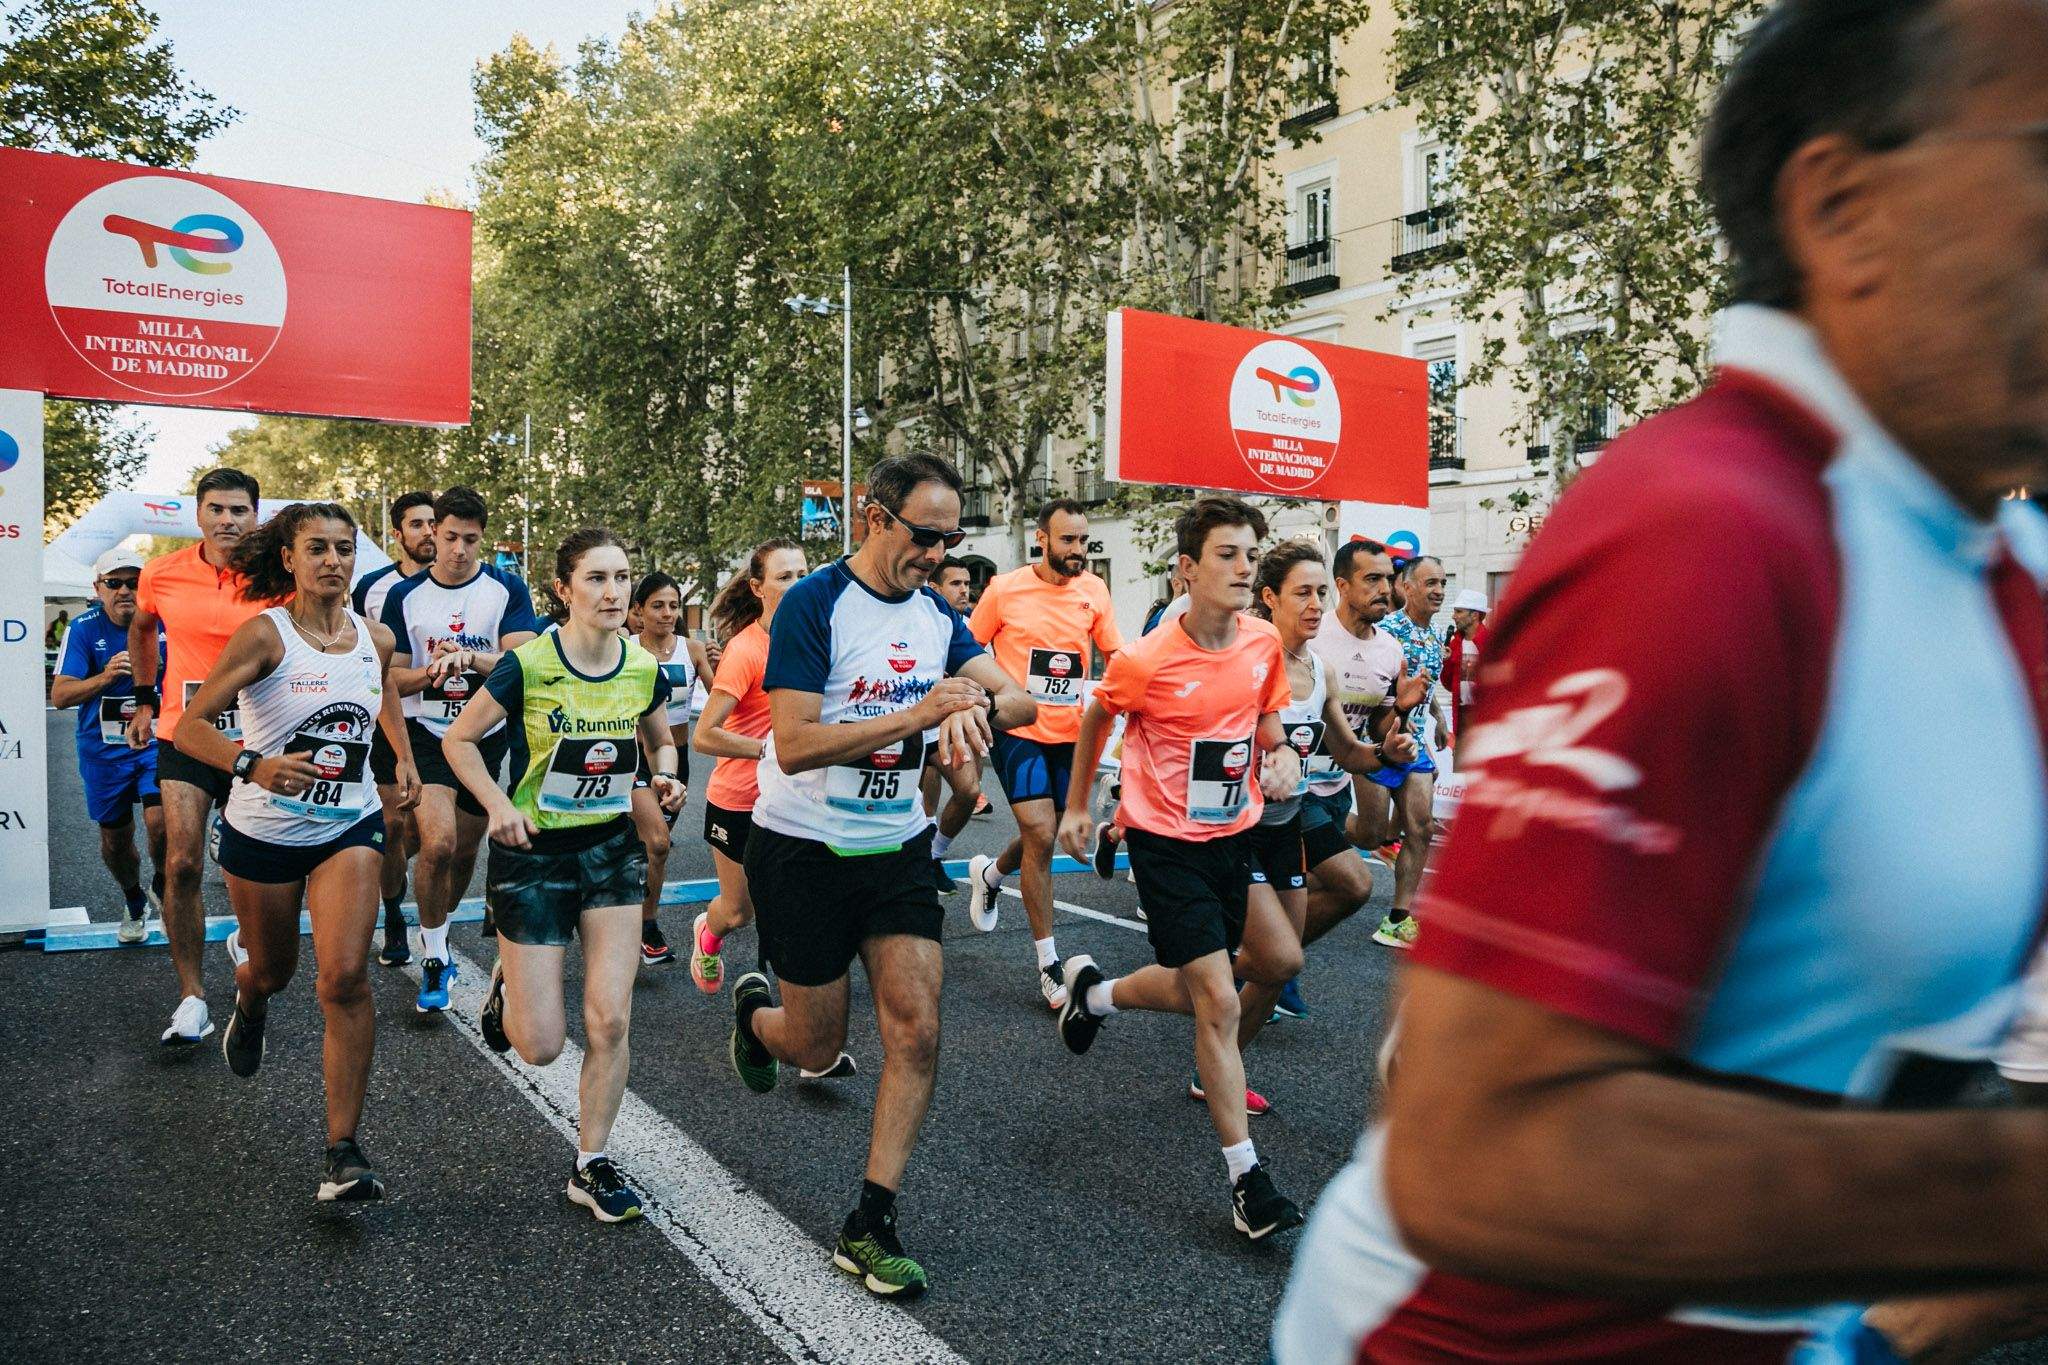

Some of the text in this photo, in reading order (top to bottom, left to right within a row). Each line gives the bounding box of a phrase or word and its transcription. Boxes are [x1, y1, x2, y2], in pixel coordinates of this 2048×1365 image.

[102, 278, 244, 306] TotalEnergies
[138, 320, 204, 340] MILLA
[111, 357, 229, 380] DE MADRID
[1256, 410, 1321, 429] TotalEnergies
[1272, 438, 1304, 452] MILLA
[1260, 463, 1315, 479] DE MADRID
[805, 486, 823, 495] ISLA
[290, 680, 329, 689] TALLERES
[1044, 677, 1071, 695] 752
[442, 701, 468, 718] 75
[215, 711, 236, 731] 61
[300, 781, 343, 806] 784
[573, 776, 612, 799] 773
[858, 771, 900, 799] 755
[1221, 780, 1243, 806] 77
